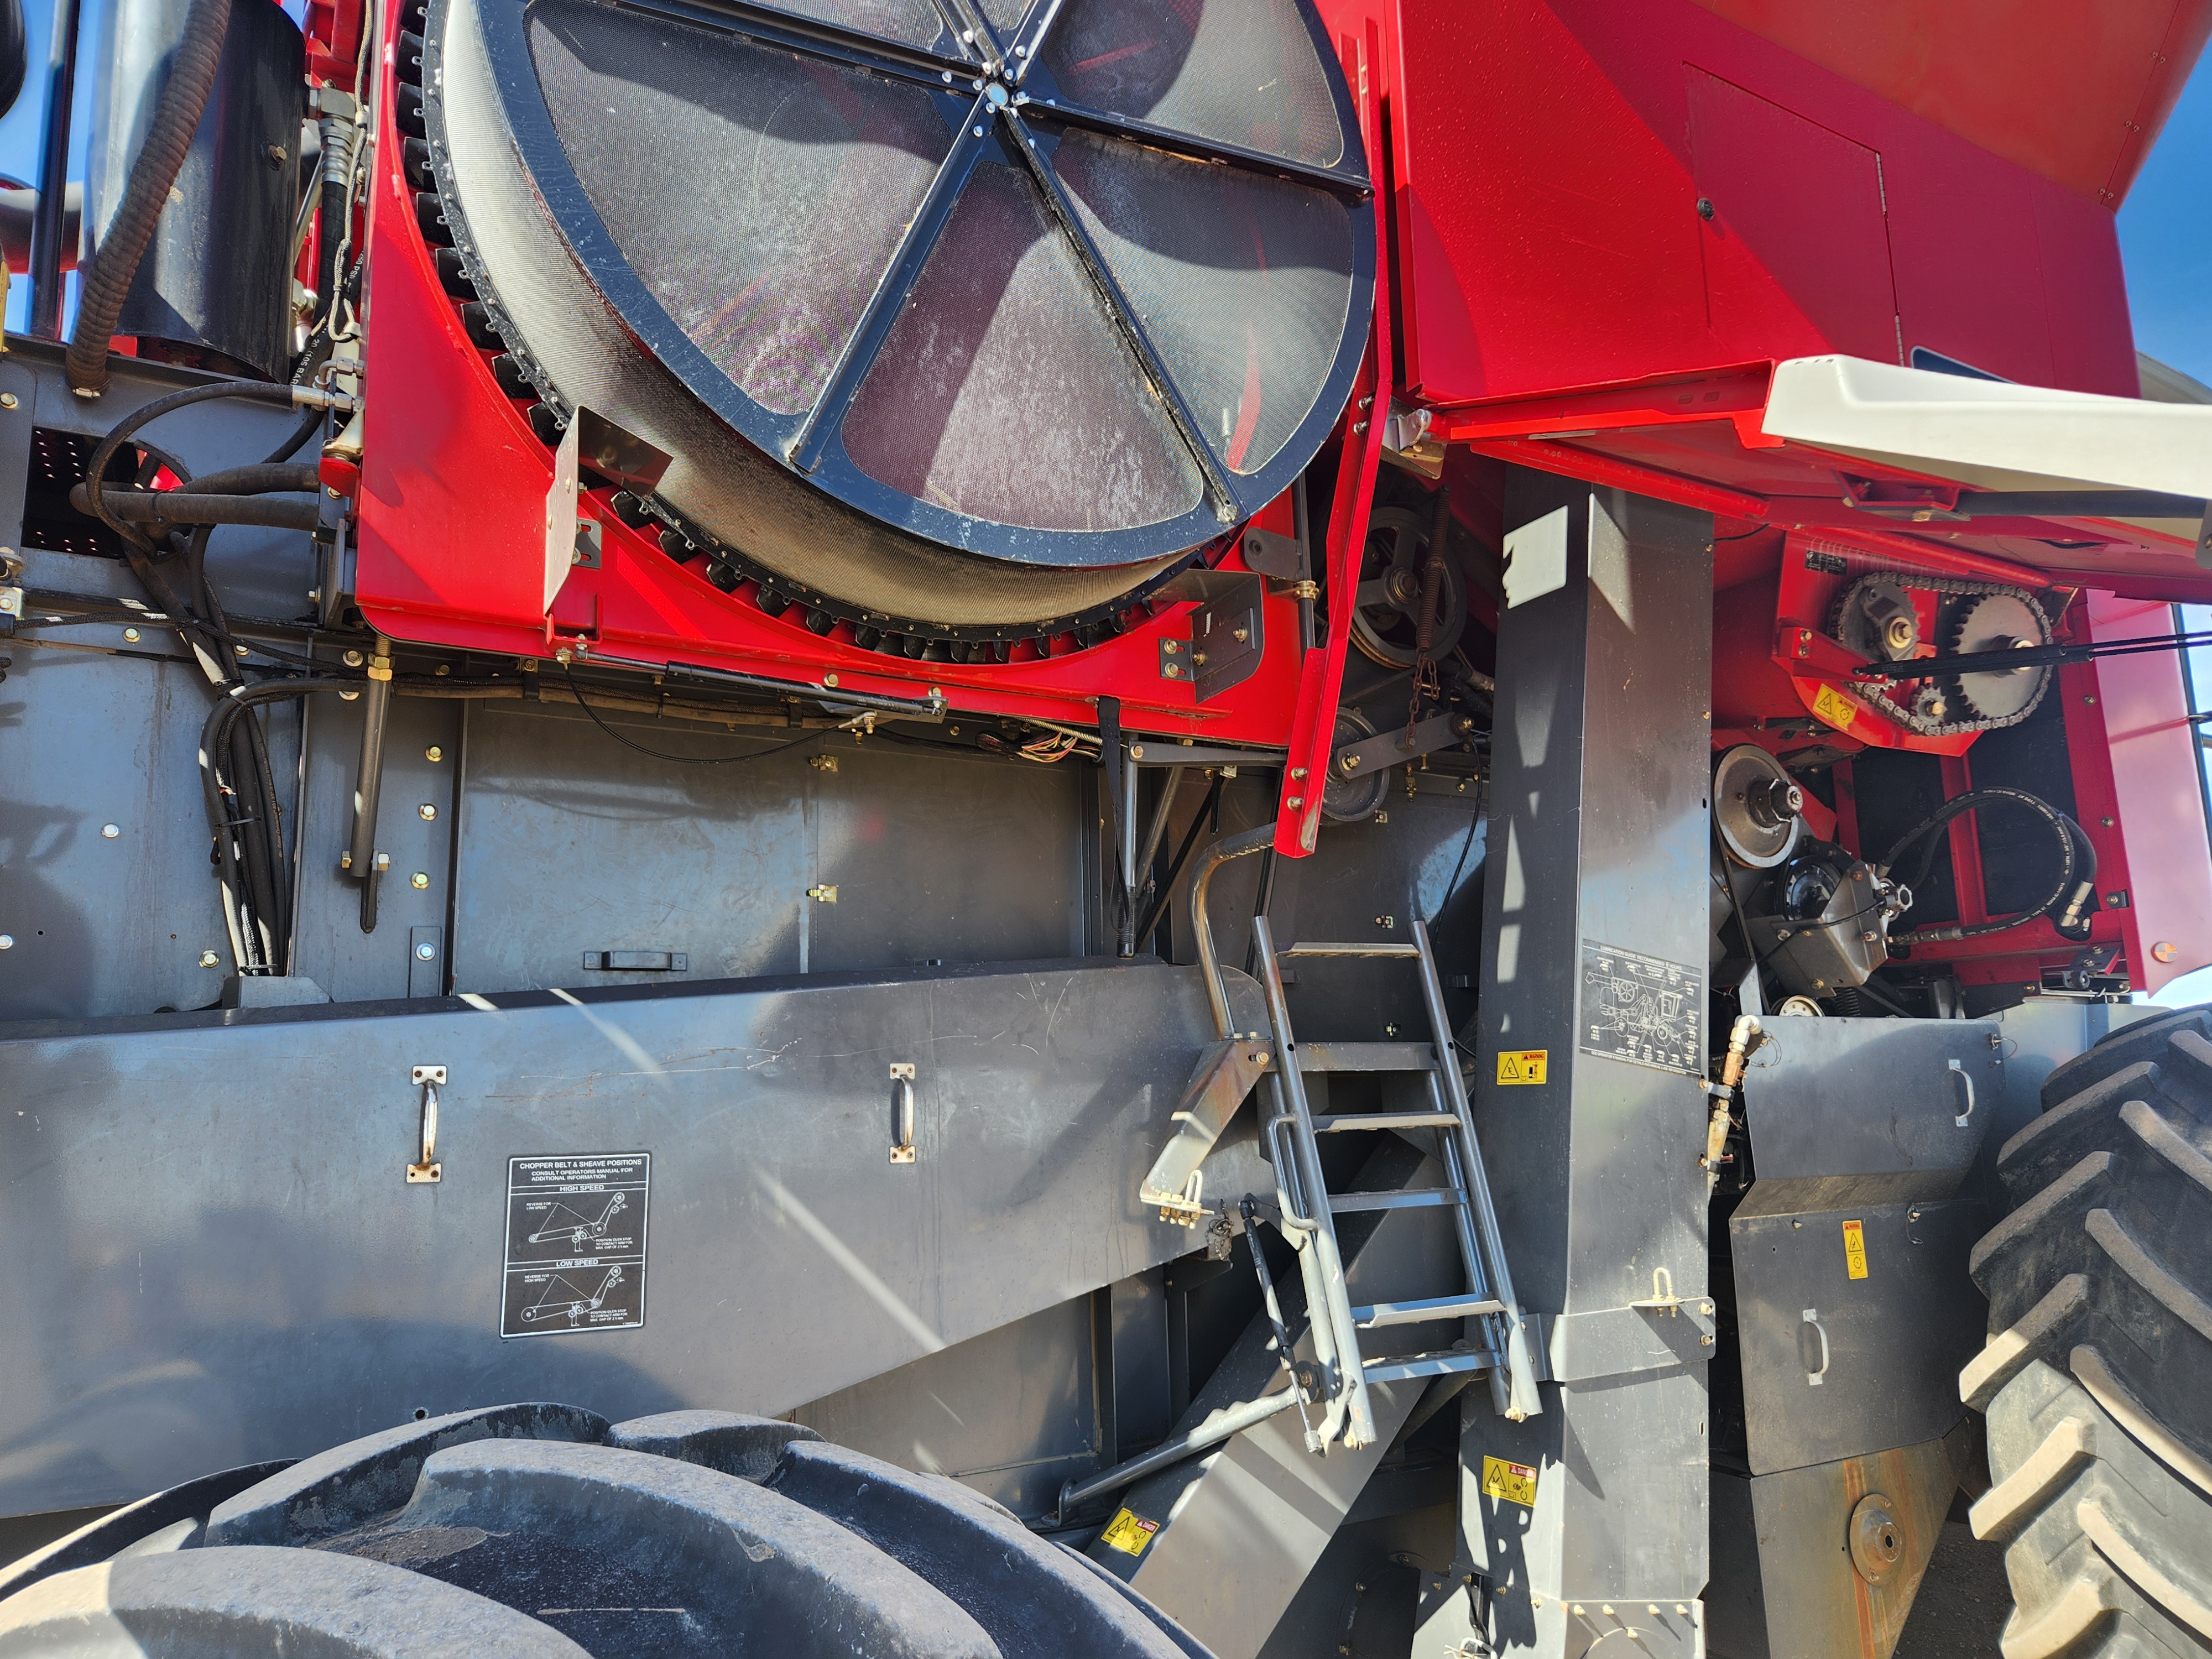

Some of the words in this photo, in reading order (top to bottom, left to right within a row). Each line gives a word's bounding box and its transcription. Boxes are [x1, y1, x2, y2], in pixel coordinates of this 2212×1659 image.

[300, 351, 314, 366] (105
[1600, 945, 1624, 956] LUBRICATION
[1636, 955, 1665, 966] RECOMMENDED
